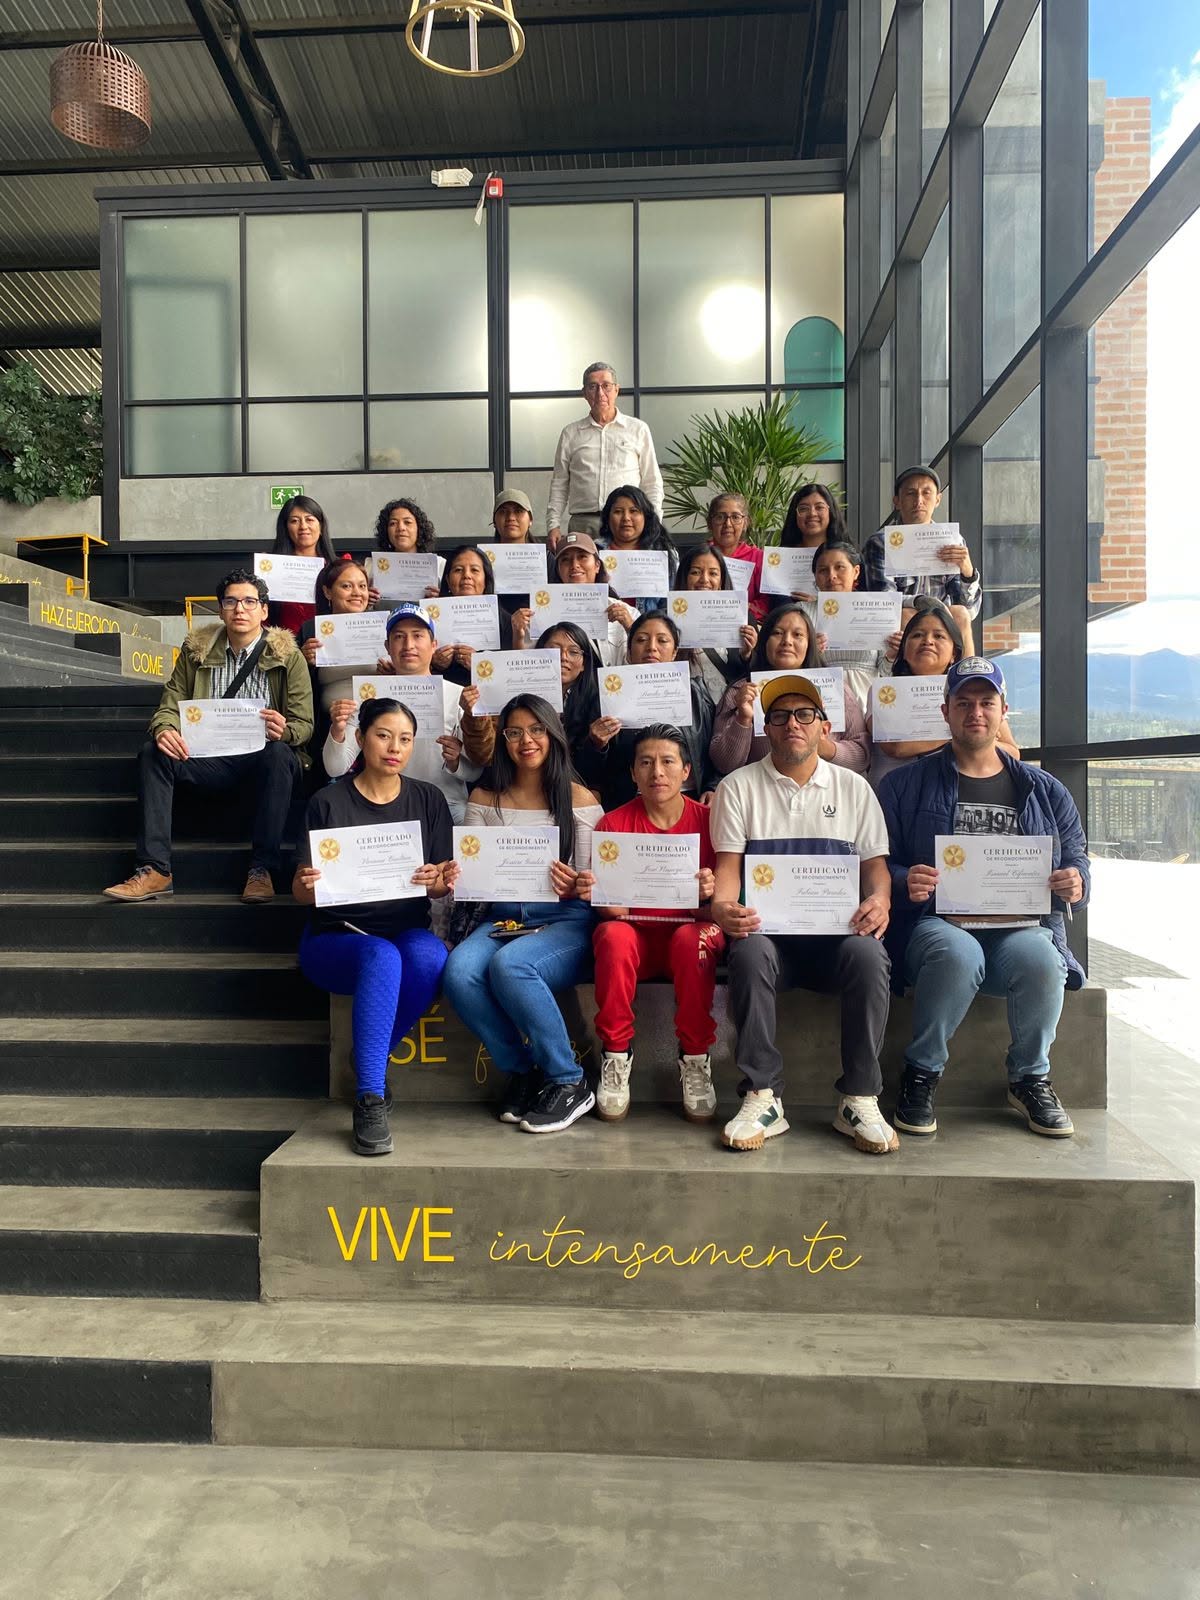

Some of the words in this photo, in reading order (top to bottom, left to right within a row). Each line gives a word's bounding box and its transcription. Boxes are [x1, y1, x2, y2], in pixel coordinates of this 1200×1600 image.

[41, 602, 64, 626] HAZ
[132, 652, 164, 676] COME
[356, 833, 412, 845] CERTIFICADO
[327, 1207, 455, 1263] VIVE
[489, 1216, 862, 1279] intensamente
